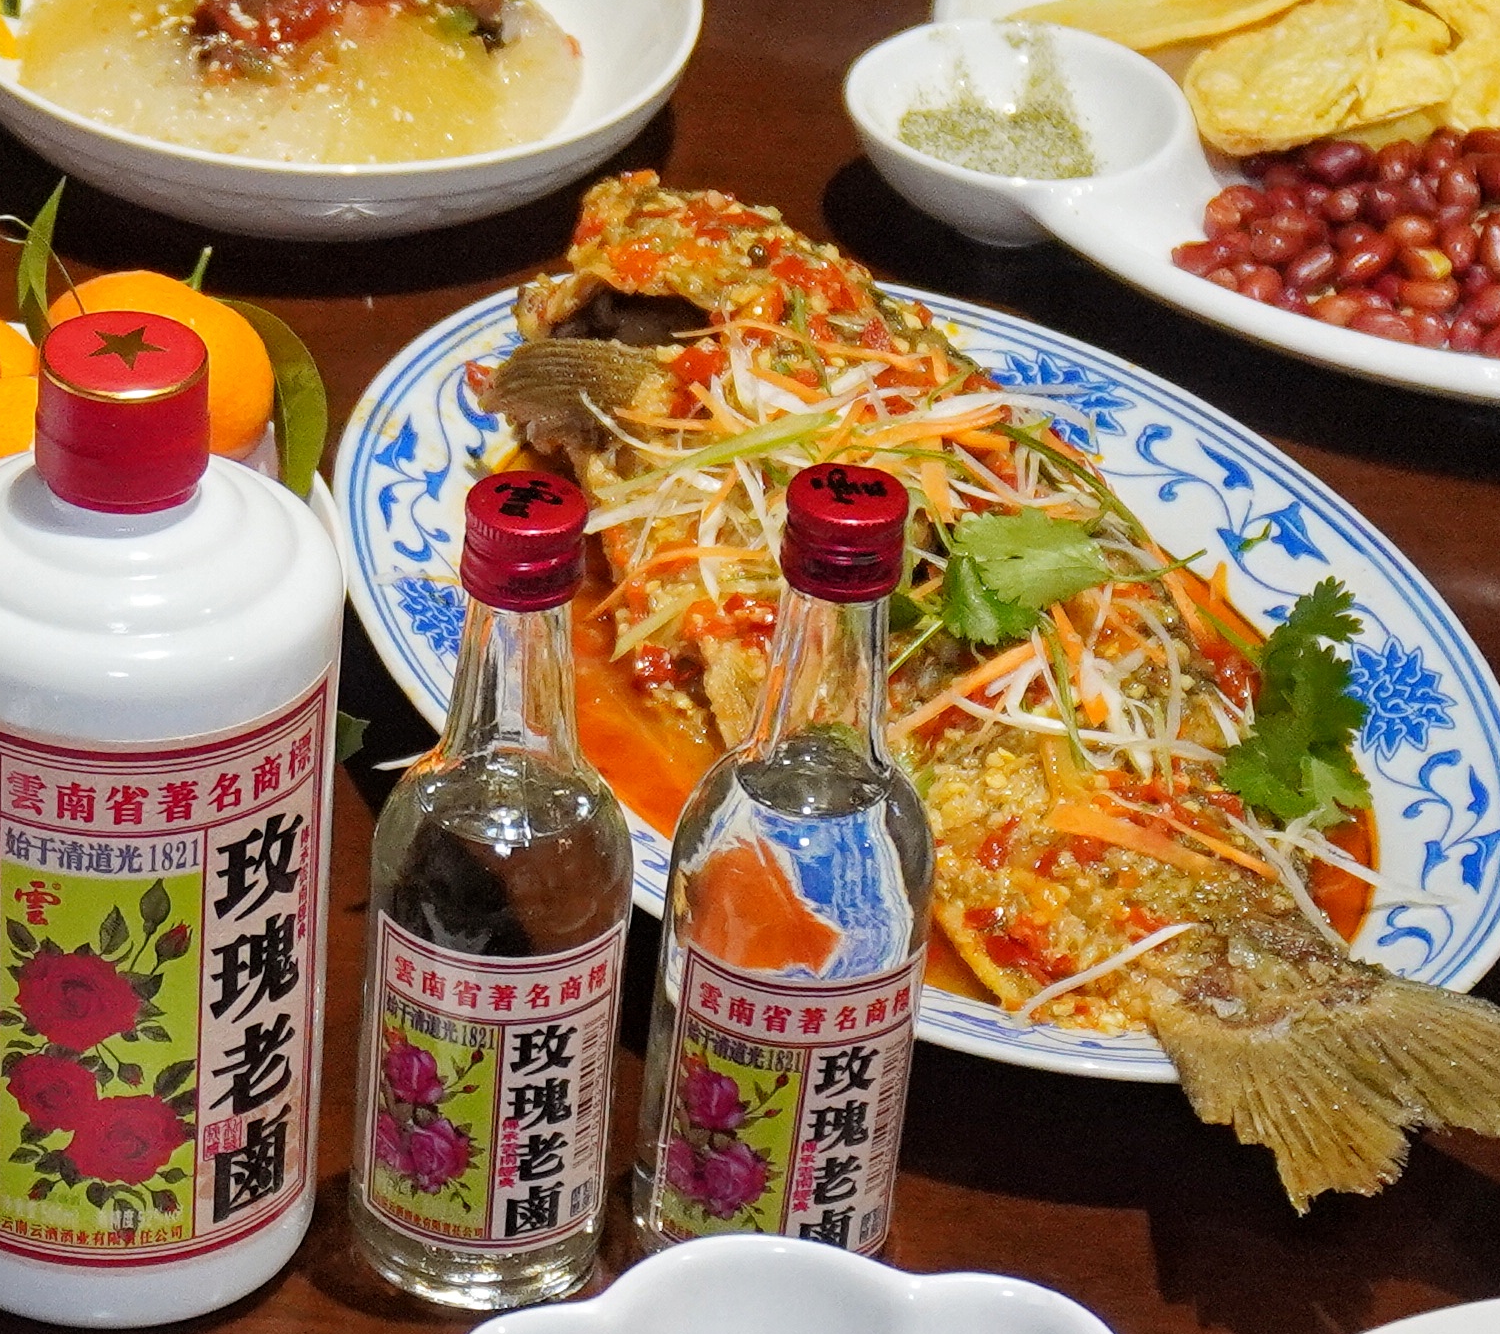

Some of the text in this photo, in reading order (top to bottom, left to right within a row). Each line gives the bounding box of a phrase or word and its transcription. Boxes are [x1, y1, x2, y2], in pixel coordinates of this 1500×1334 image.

[6, 727, 313, 826] 雲南省著名商標
[4, 826, 200, 873] 始于清道光1821
[393, 954, 609, 1013] 雲南省著名商標
[699, 980, 911, 1035] 雲南省著名商標
